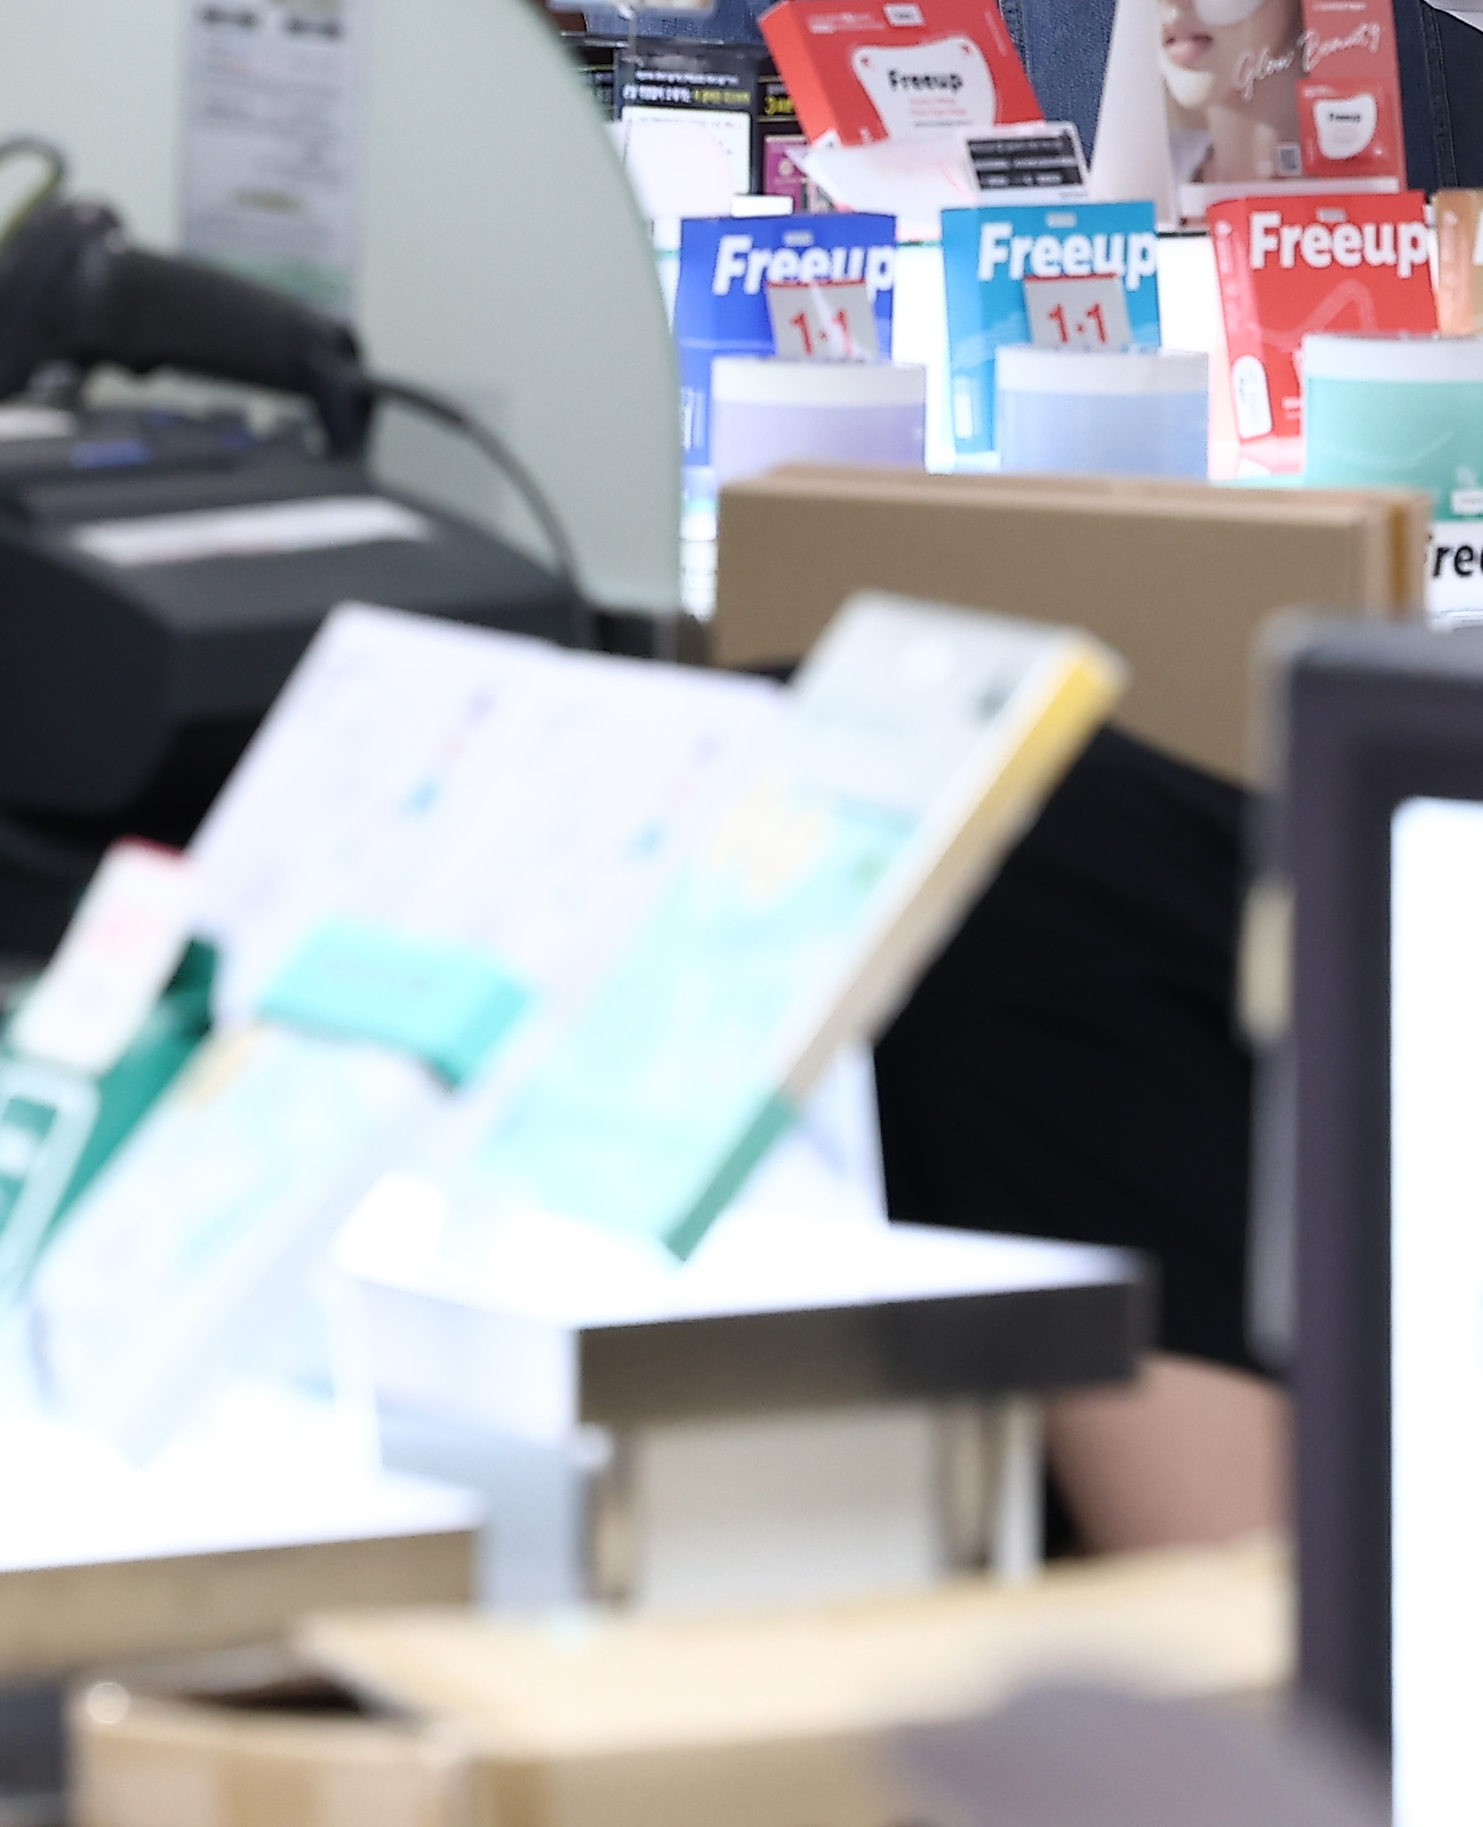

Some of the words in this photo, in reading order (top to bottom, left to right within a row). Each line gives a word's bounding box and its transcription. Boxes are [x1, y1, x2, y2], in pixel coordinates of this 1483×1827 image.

[712, 233, 897, 295] Freeup
[978, 221, 1158, 291] Freeup
[1249, 210, 1433, 278] Freeup
